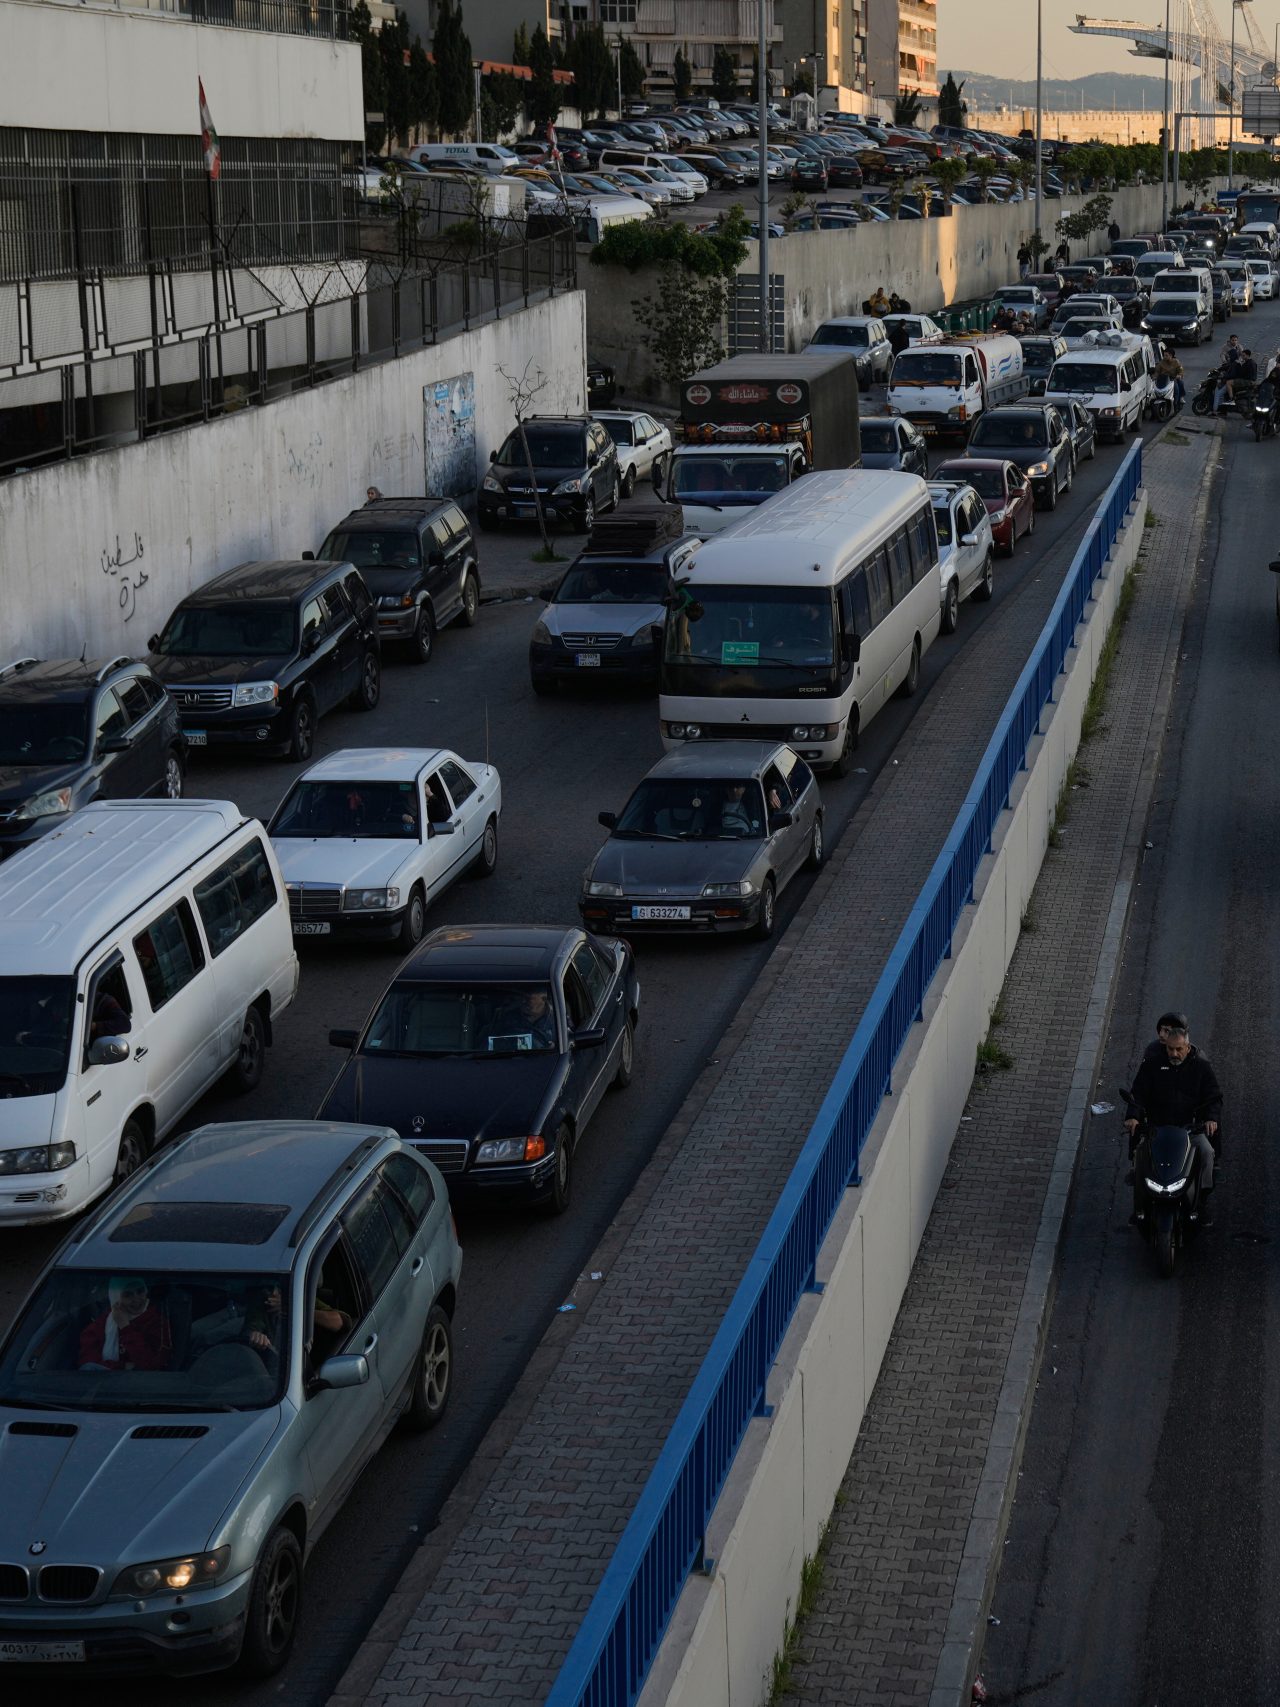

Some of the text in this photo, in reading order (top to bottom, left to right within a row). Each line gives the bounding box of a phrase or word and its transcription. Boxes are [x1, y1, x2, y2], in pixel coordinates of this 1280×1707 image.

[101, 531, 144, 575] فلسطين
[119, 570, 149, 623] حرة
[639, 907, 683, 919] G 633274
